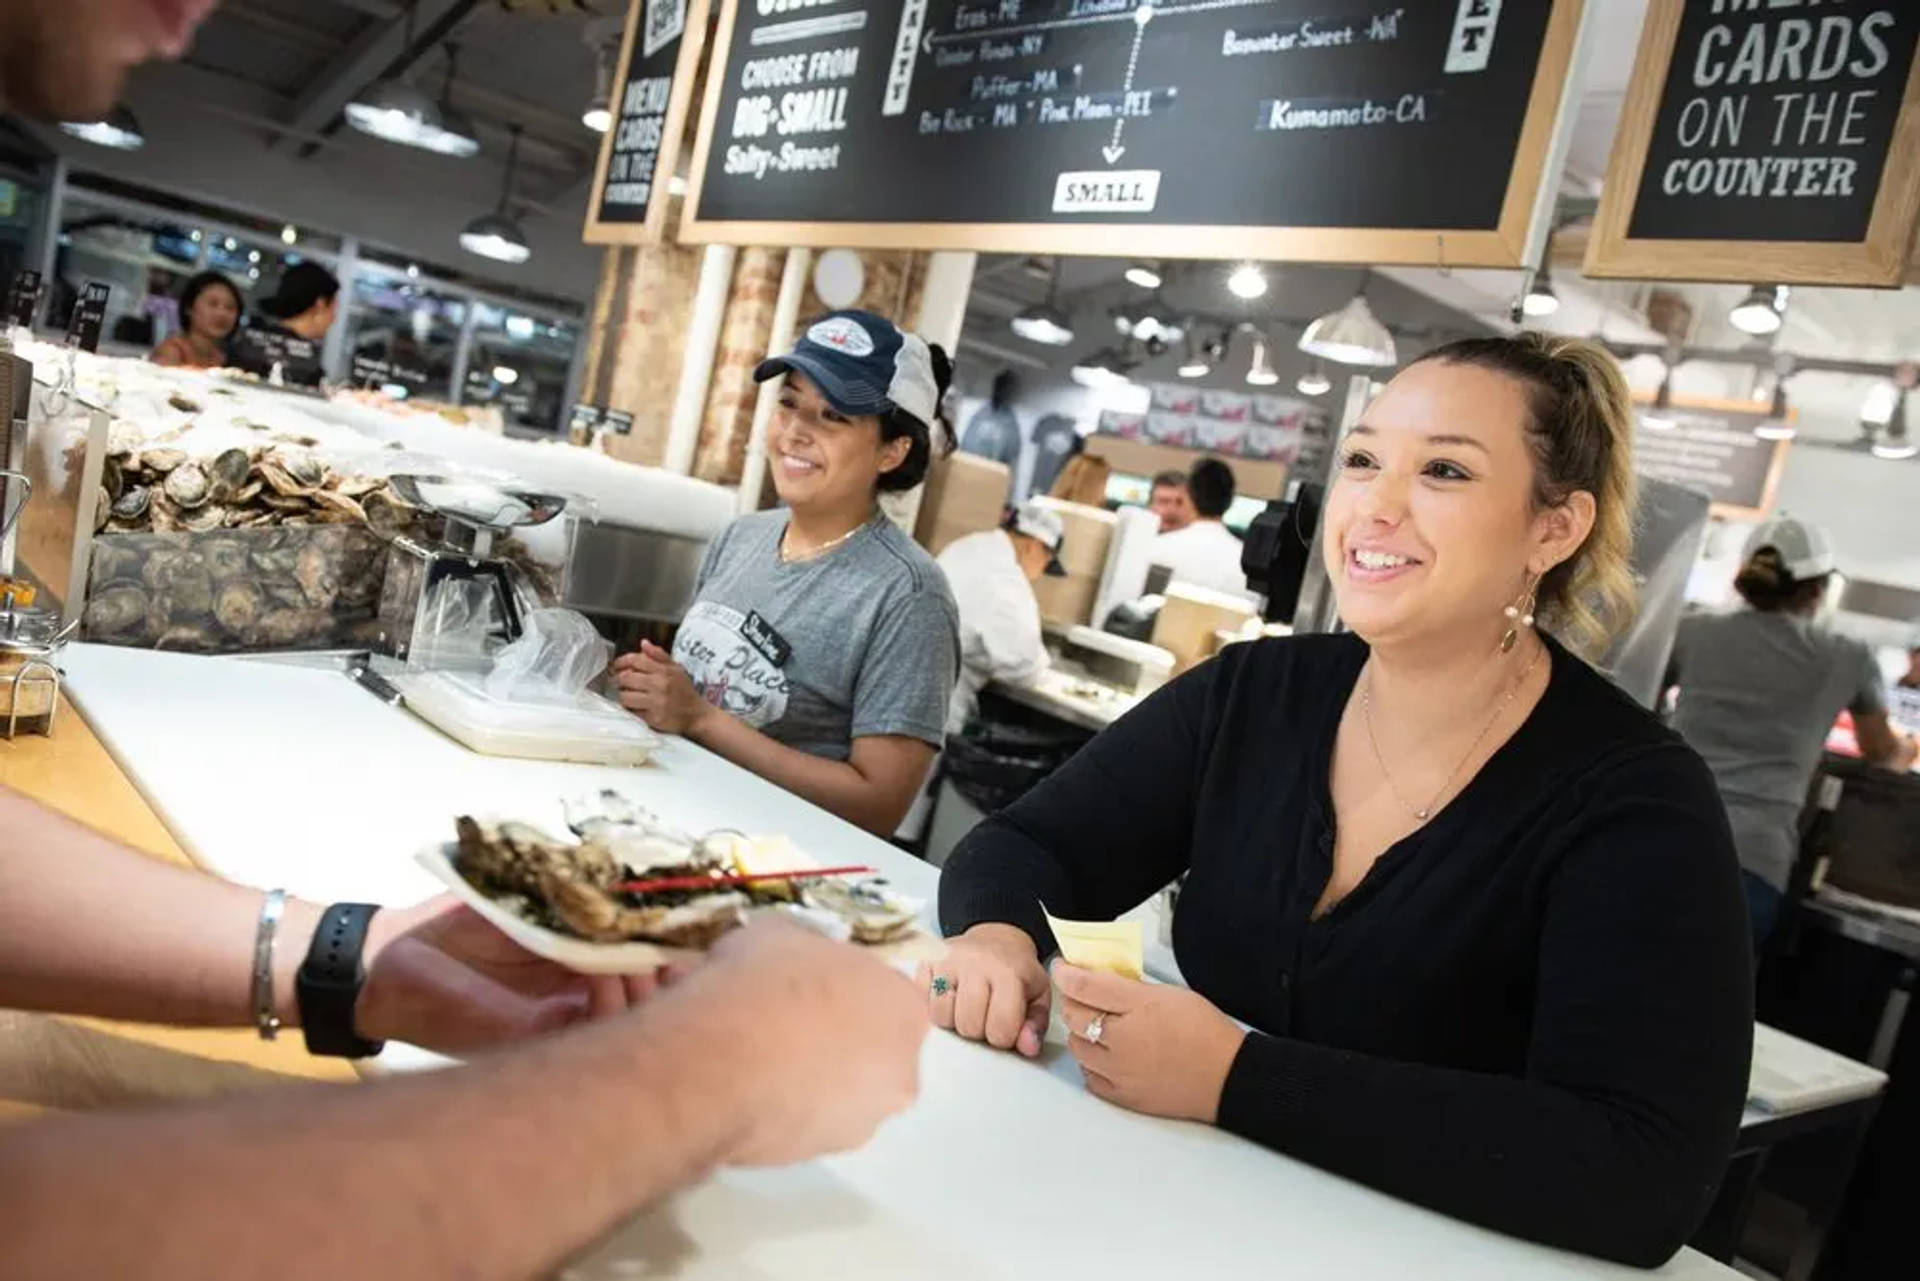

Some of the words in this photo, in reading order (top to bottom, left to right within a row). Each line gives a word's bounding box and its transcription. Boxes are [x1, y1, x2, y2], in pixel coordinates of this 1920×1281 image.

[1299, 21, 1354, 48] Sweet
[1693, 11, 1895, 87] CARDS
[741, 53, 808, 91] CHOOSE
[807, 47, 859, 82] FROM
[1677, 95, 1748, 148] ON
[1771, 90, 1878, 147] THE
[1065, 183, 1145, 202] SMALL
[1662, 157, 1857, 196] COUNTER
